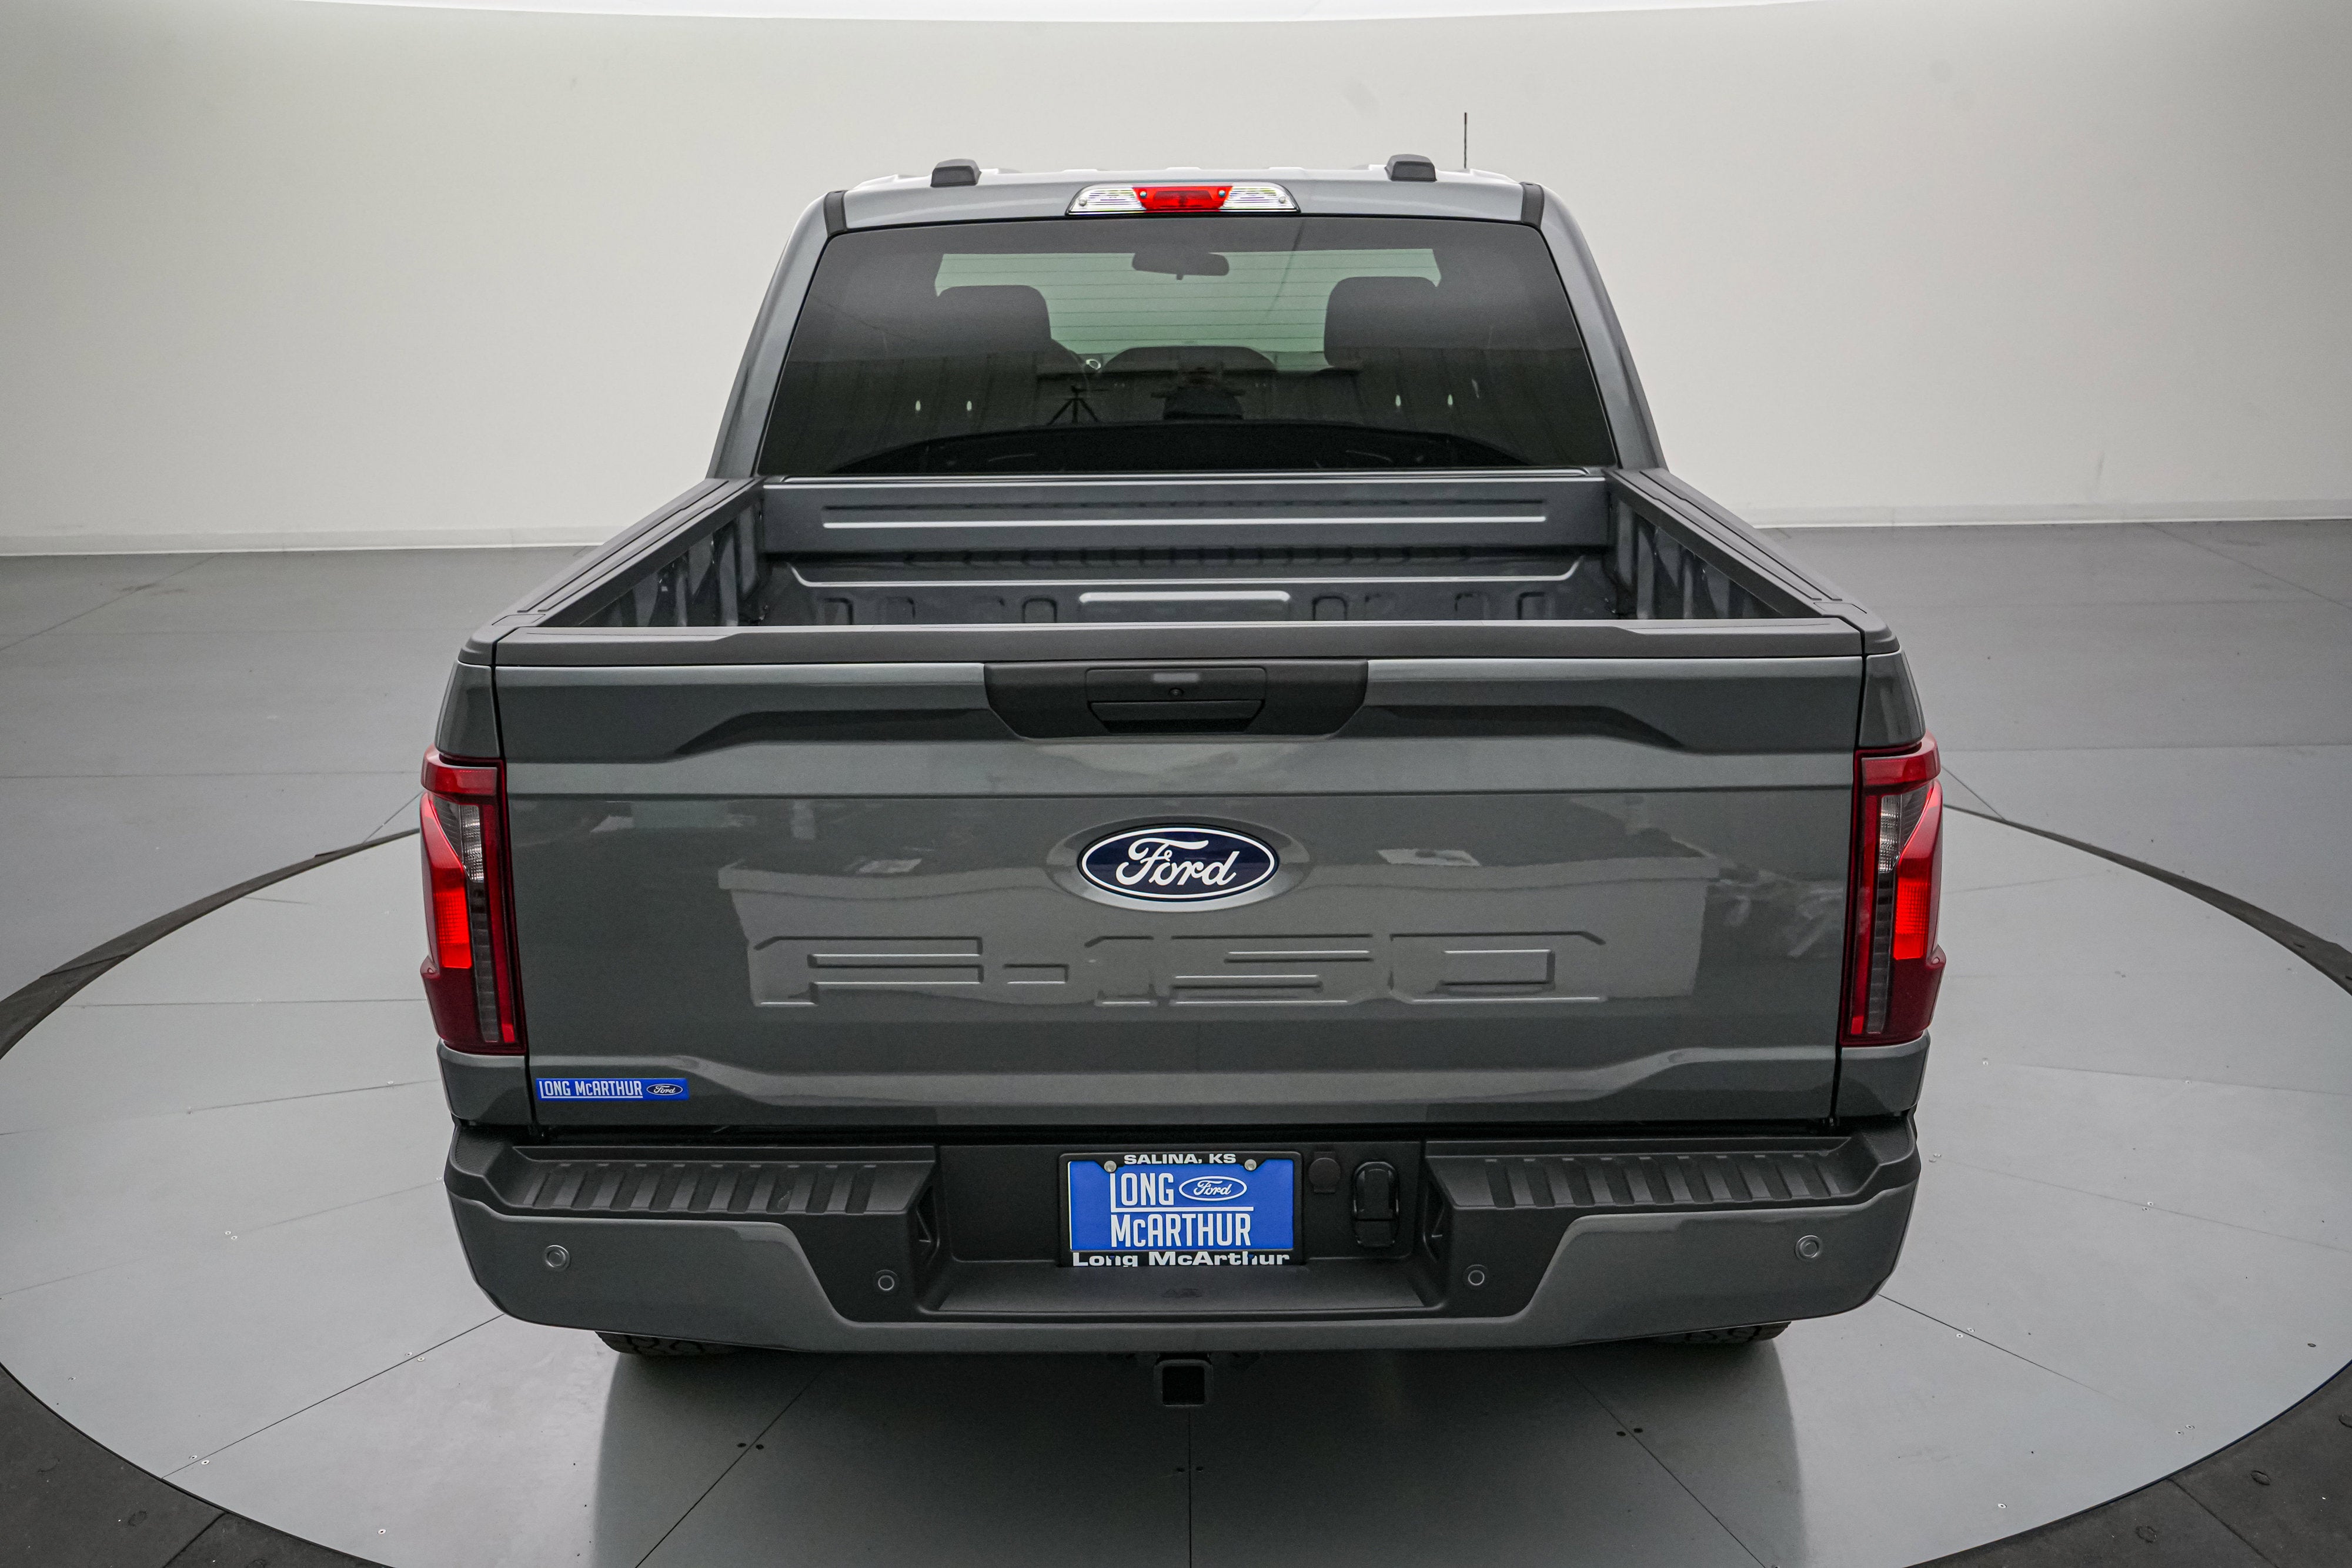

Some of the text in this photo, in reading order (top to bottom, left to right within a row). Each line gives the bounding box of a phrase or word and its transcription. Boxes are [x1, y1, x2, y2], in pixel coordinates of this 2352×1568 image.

[1116, 838, 1240, 885] Ford
[751, 931, 1606, 1006] F-150
[539, 1081, 643, 1098] LONG McARTHUR
[653, 1085, 676, 1094] Ford
[1124, 1154, 1236, 1165] SALINA, KS
[1110, 1173, 1174, 1212] LONG
[1193, 1179, 1232, 1196] Ford
[1111, 1213, 1251, 1248] McARTHUR
[1073, 1251, 1290, 1267] Long McArthur
